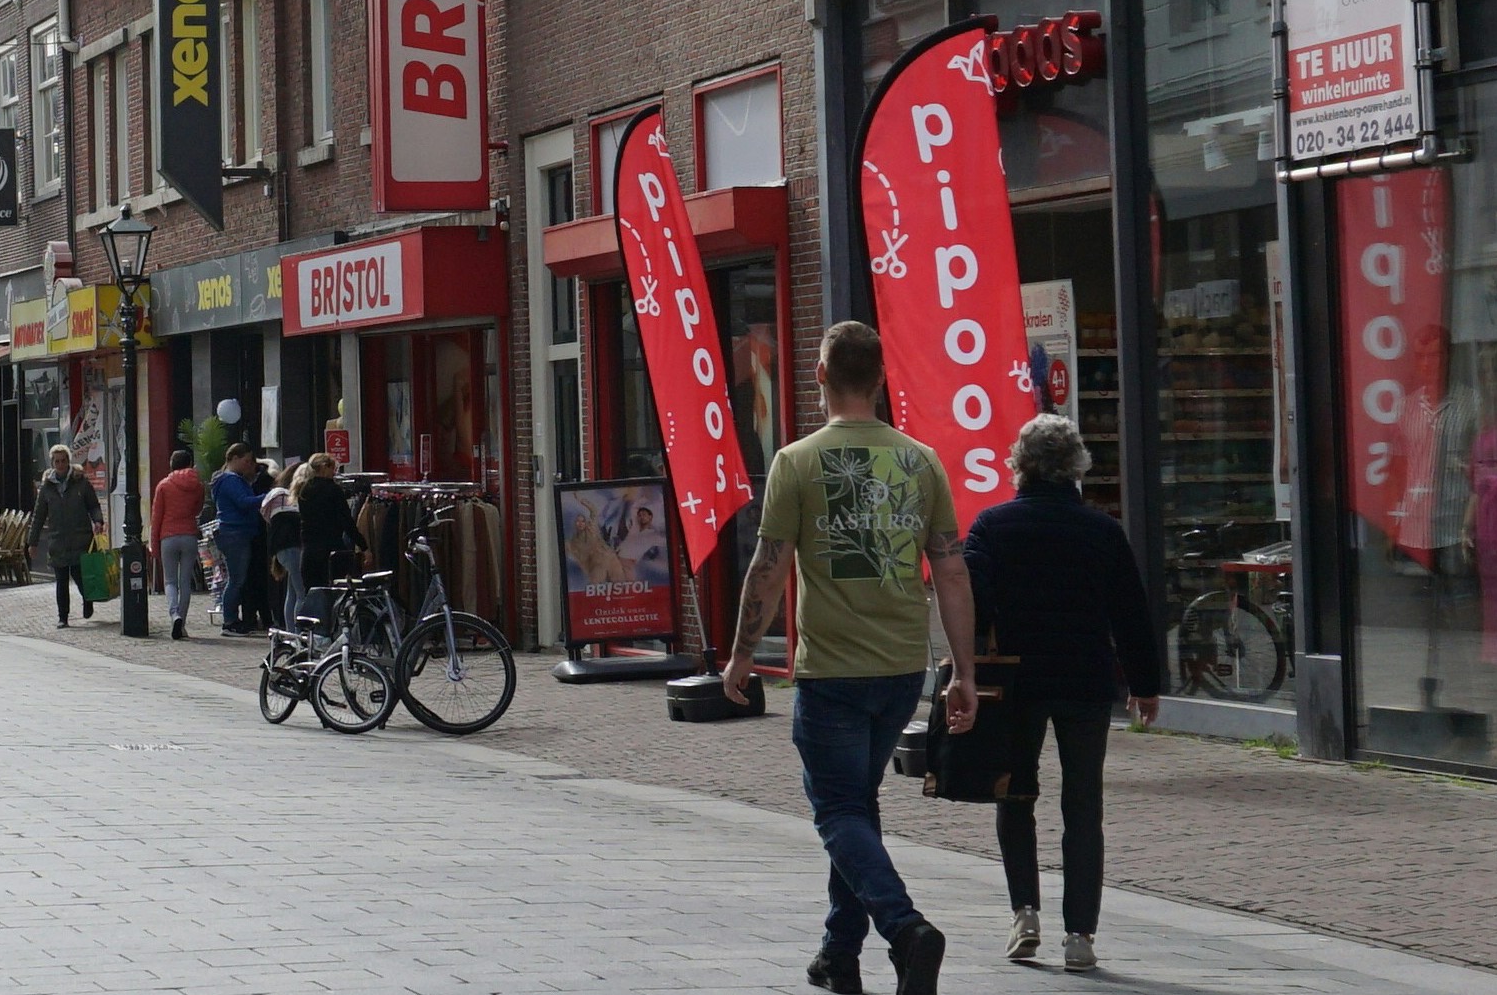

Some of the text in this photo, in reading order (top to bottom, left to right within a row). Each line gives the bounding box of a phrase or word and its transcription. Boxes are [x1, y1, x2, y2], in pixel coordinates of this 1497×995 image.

[1296, 33, 1394, 80] TE HUUR
[1301, 71, 1391, 106] winkelruimte
[1296, 130, 1325, 155] 020
[1336, 125, 1356, 148] 34
[1360, 120, 1380, 144] 22
[1384, 112, 1415, 138] 444
[197, 274, 233, 311] xenos
[311, 256, 391, 324] BRISTOL
[910, 102, 1000, 493] pipoos
[638, 171, 726, 494] pipoos
[586, 580, 653, 602] BRISTOL
[583, 613, 659, 625] LENTECOLLECTIE
